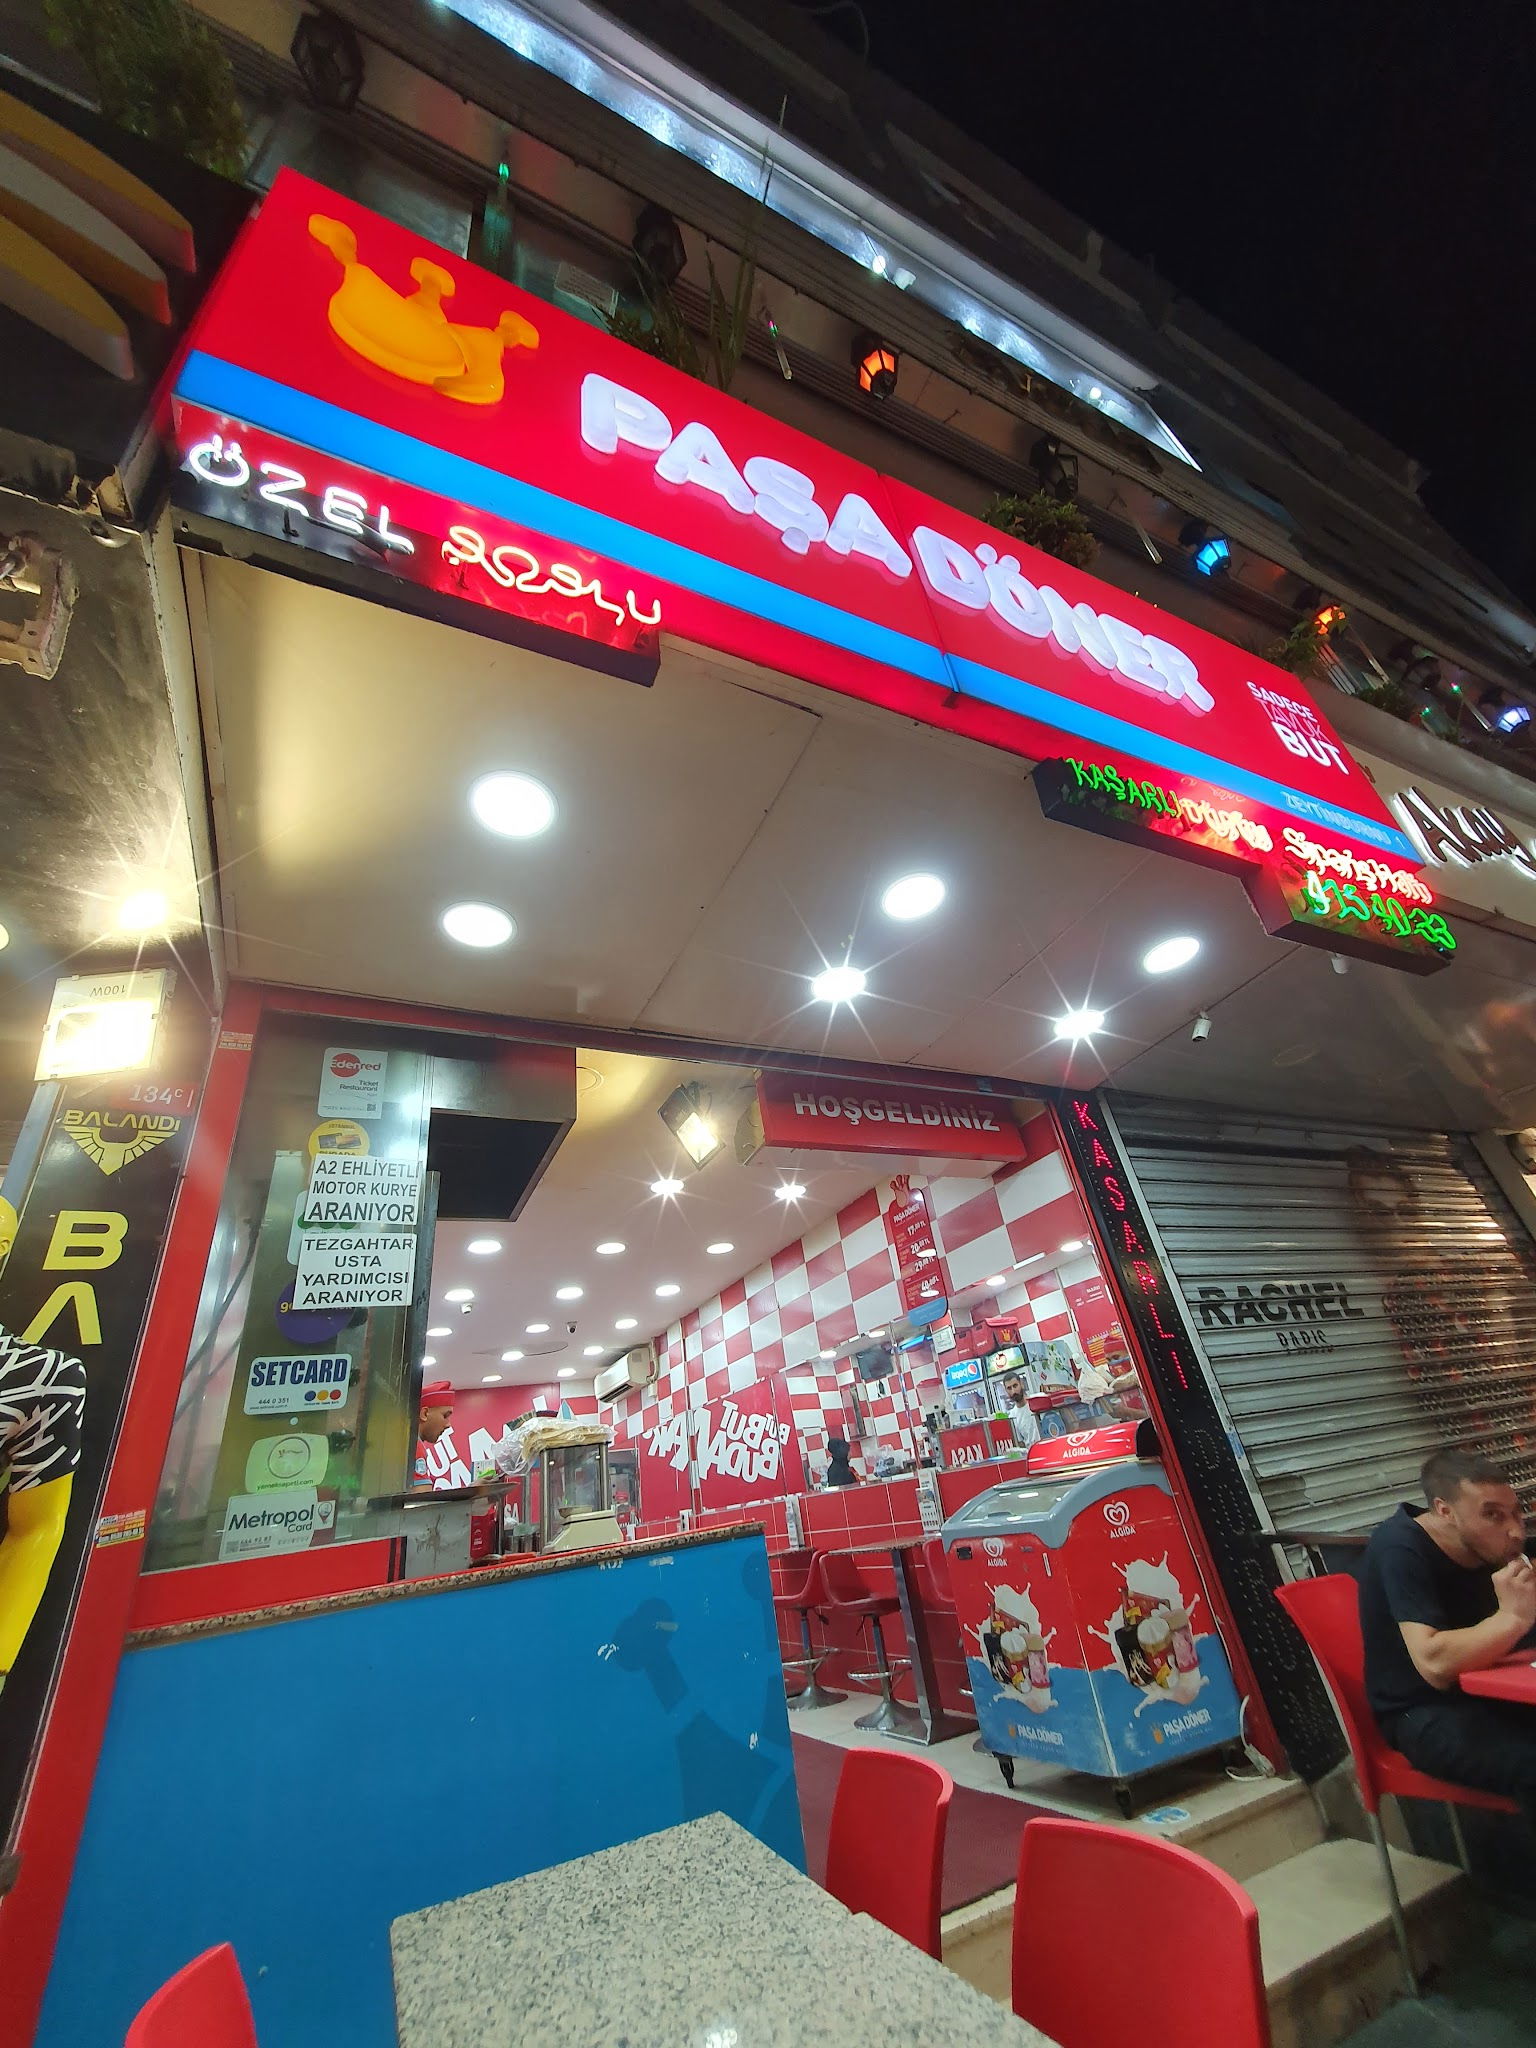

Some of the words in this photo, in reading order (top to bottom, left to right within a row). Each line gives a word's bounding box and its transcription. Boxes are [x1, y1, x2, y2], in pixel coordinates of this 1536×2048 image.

[188, 433, 416, 555] ÖZEL
[580, 373, 912, 577] PAŞA
[912, 525, 1215, 712] DÖNER
[1247, 681, 1317, 723] SADECE
[1255, 697, 1334, 746] TAVUK
[1271, 721, 1349, 775] BUT
[330, 1060, 382, 1071] Edenred
[63, 1109, 181, 1132] BALANDI
[793, 1092, 1000, 1132] HOŞGELDİNİZ
[316, 1160, 337, 1174] A2
[313, 1181, 367, 1195] MOTOR
[370, 1182, 418, 1197] KURYE
[308, 1202, 415, 1222] ARANIYOR
[304, 1238, 413, 1251] TEZGAHTAR
[334, 1255, 382, 1268] USTA
[302, 1272, 409, 1287] YARDIMCISI
[302, 1290, 403, 1305] ARANIYOR
[1197, 1282, 1365, 1326] RACHEL
[251, 1358, 348, 1387] SETCARD
[228, 1504, 315, 1532] Metropol
[287, 1521, 313, 1533] Card
[1163, 1717, 1187, 1738] PAŞA
[1182, 1708, 1211, 1730] DÖNER
[1017, 1724, 1038, 1741] PAŞA
[1037, 1726, 1065, 1746] DÖNER
